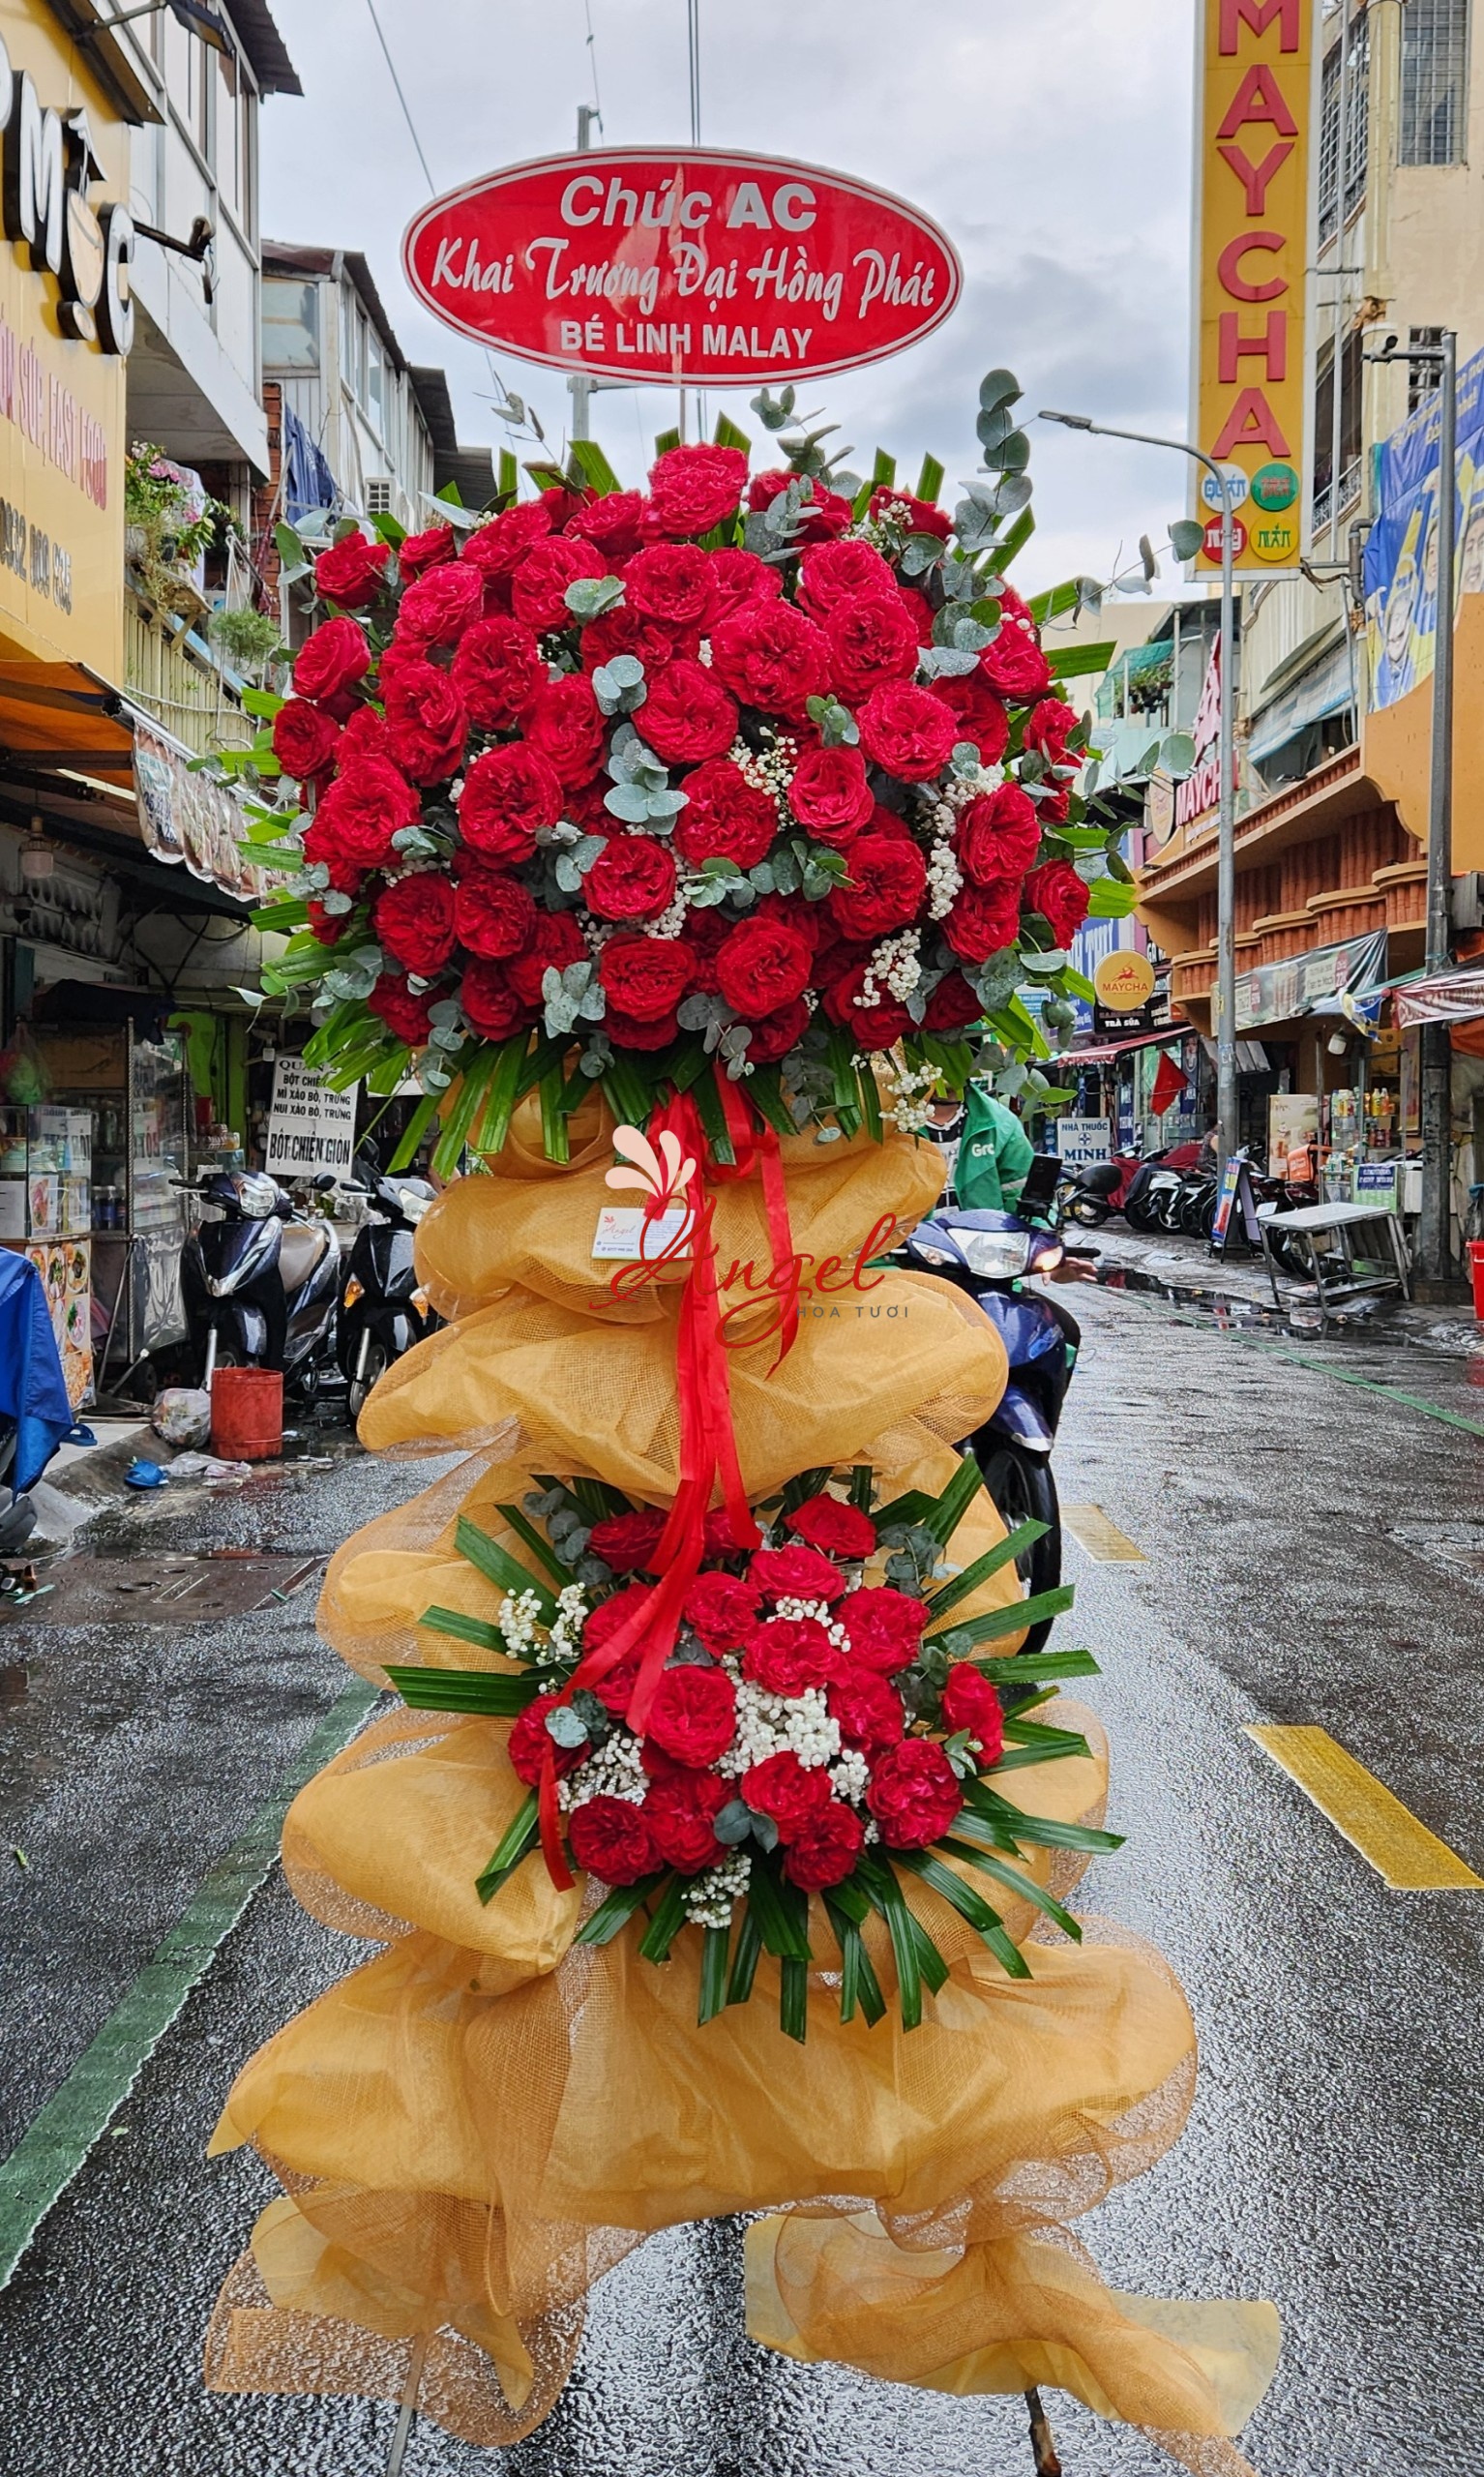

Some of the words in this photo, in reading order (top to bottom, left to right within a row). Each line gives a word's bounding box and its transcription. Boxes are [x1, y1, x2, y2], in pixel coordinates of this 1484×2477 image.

[560, 175, 711, 229] Chúc
[727, 182, 817, 232] AC
[1210, 0, 1300, 459] MAYCHA
[430, 236, 514, 294] Khai
[669, 241, 738, 313] Đại
[748, 246, 845, 322] Hồng
[853, 249, 935, 319] Phát
[559, 314, 605, 351] BÉ
[616, 323, 692, 354] LINH
[703, 325, 813, 359] MALAY
[1175, 756, 1231, 827] MAYCH
[1102, 982, 1148, 992] MAYCHA
[290, 1089, 306, 1101] XÀO
[302, 1073, 325, 1088] CHIÊ
[273, 1103, 288, 1115] NUI
[289, 1104, 307, 1116] XÀO
[1064, 1148, 1108, 1161] MINH
